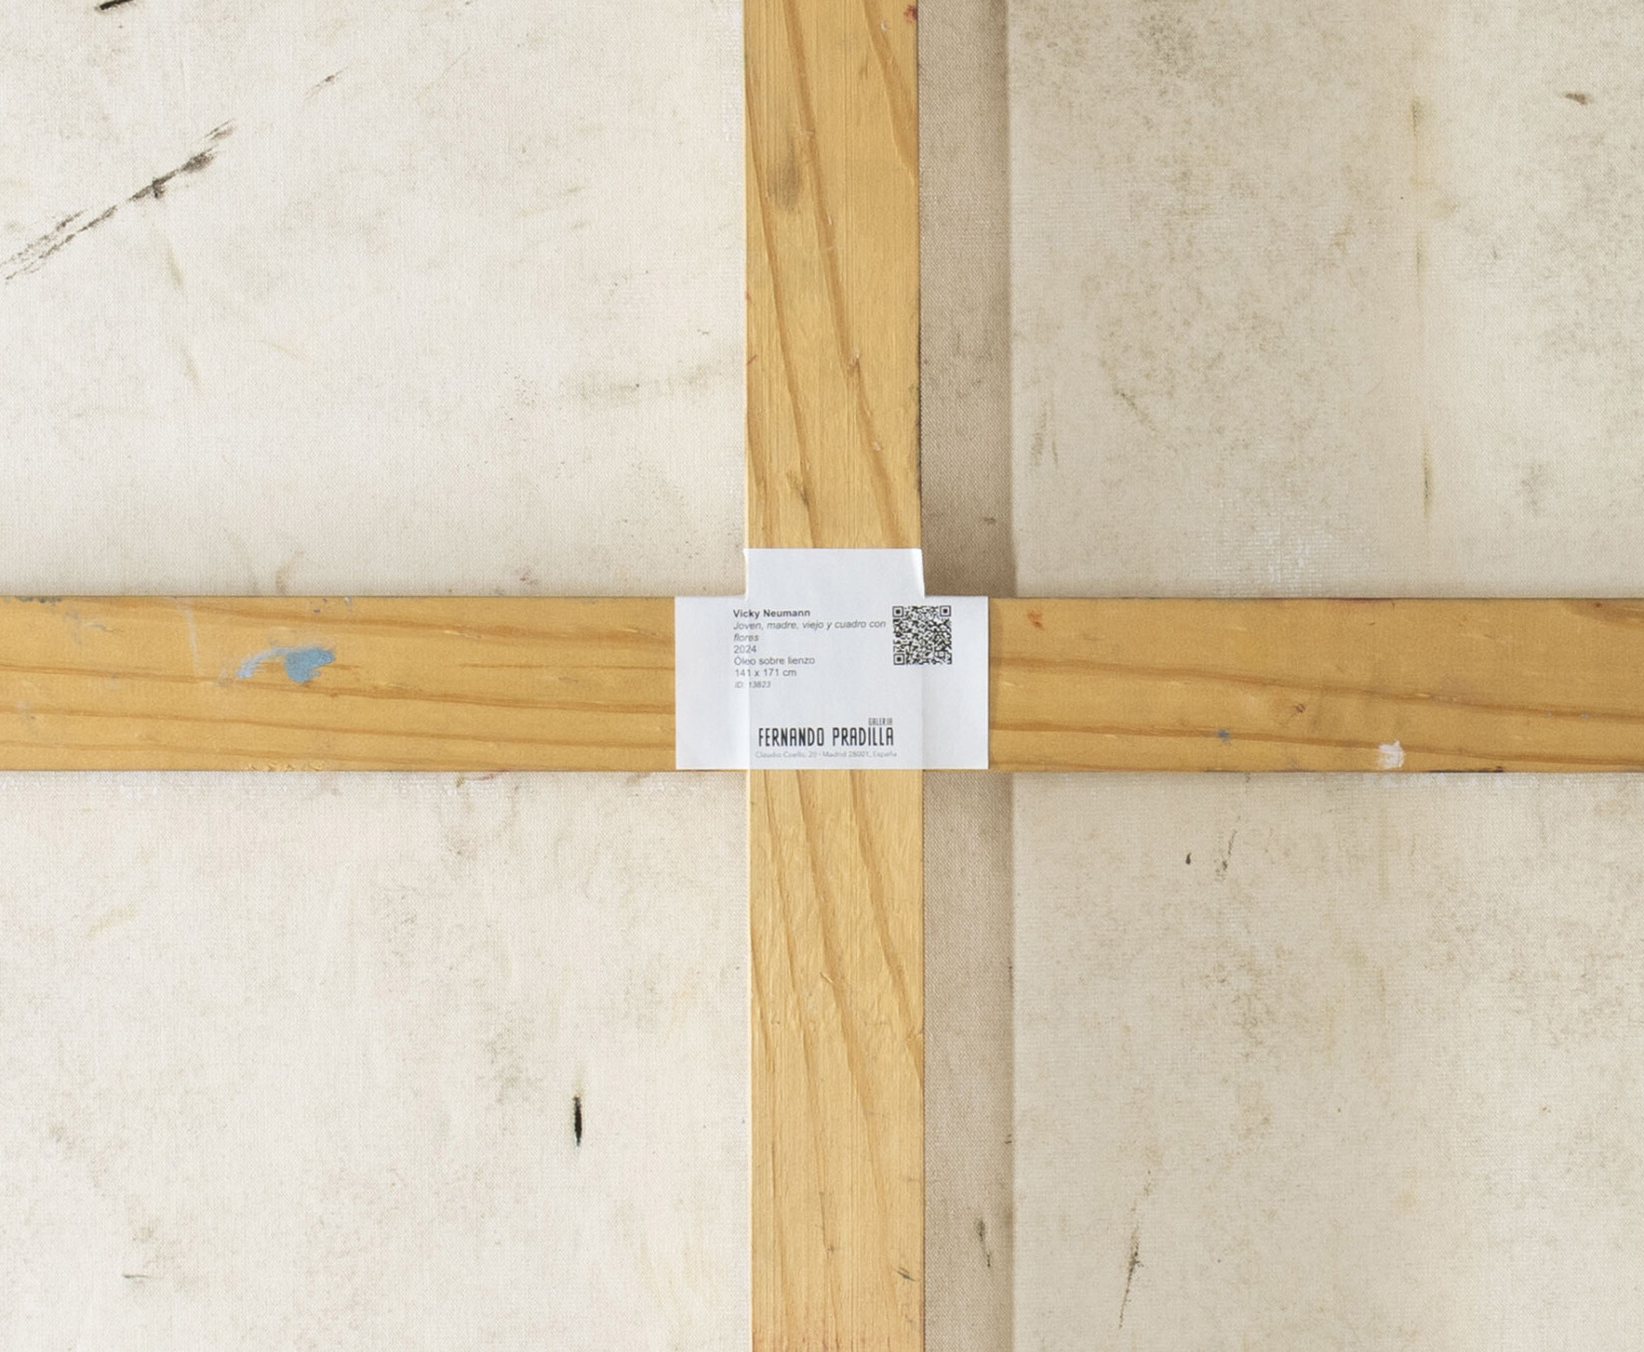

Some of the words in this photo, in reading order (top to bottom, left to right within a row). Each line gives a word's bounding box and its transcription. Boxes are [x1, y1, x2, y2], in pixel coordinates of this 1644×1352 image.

[733, 609, 760, 619] Vicky
[763, 609, 811, 618] Neumann
[733, 622, 764, 631] Joven,
[802, 621, 824, 631] viejo
[834, 620, 867, 629] cuadro
[869, 621, 887, 629] con
[733, 633, 760, 642] flores
[733, 645, 757, 654] 2024
[758, 656, 785, 665] sobre
[788, 656, 816, 665] lienzo
[735, 669, 752, 678] 141
[763, 668, 779, 677] 171
[782, 669, 797, 678] cm
[758, 727, 825, 747] FERNANDO
[832, 727, 894, 747] PRADILLA
